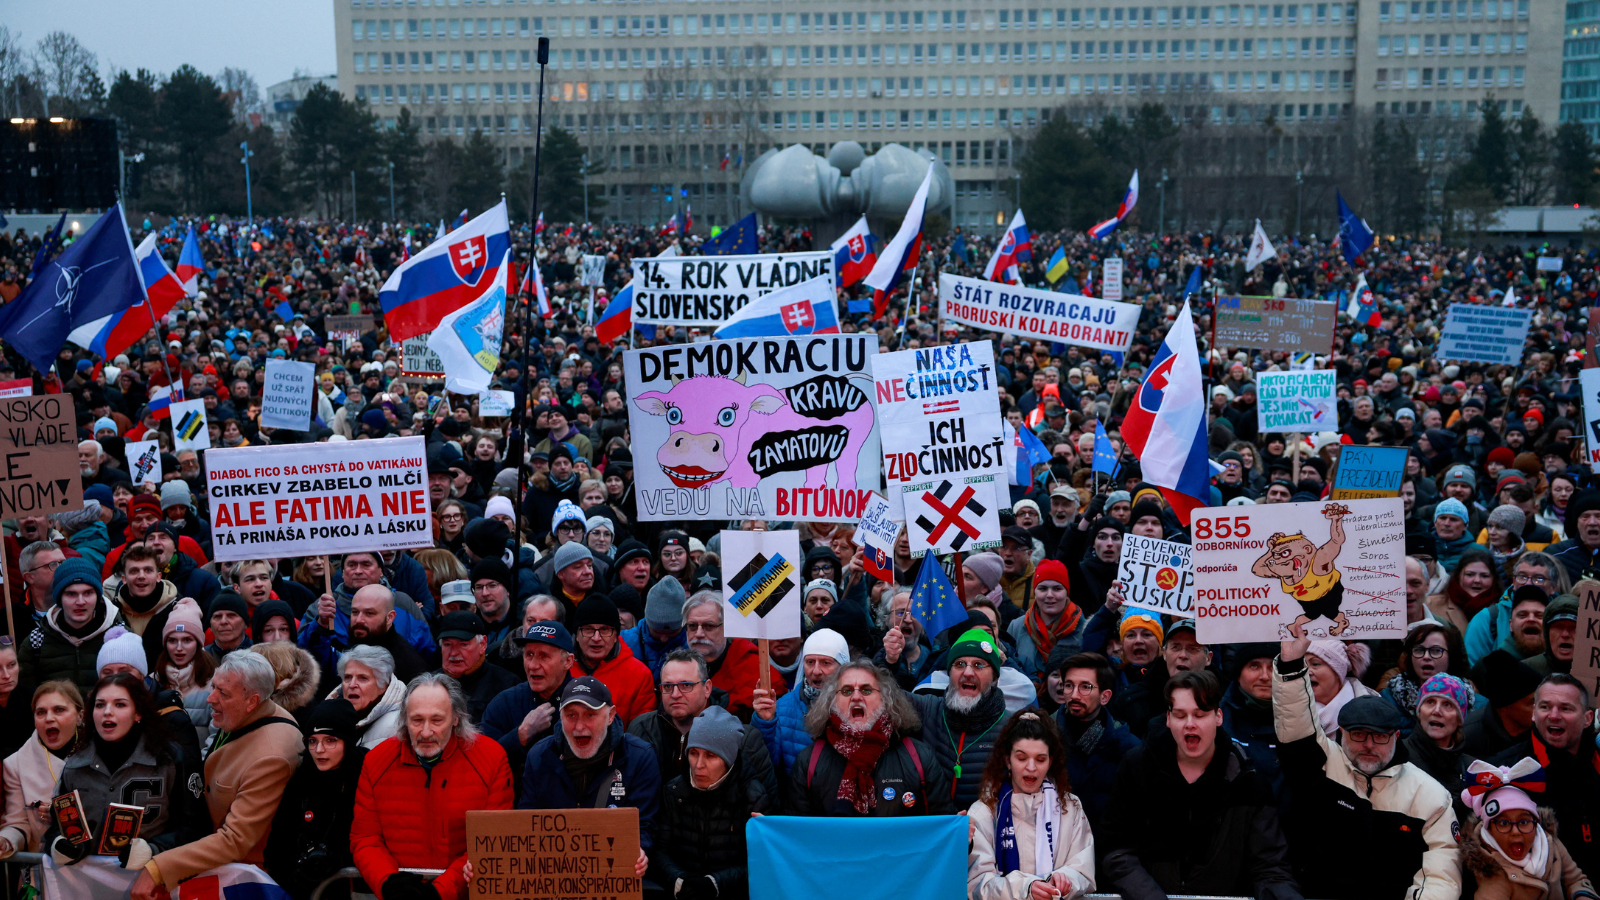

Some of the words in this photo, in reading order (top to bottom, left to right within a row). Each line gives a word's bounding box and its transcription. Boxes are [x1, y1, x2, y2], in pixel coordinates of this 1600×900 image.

[639, 261, 670, 289] 14.
[681, 262, 728, 289] ROK
[635, 292, 750, 320] SLOVENSKO
[954, 281, 993, 305] ŠTÁT
[999, 292, 1116, 325] ROZVRACAJÚ
[946, 300, 1016, 329] PRORUSKÍ
[1018, 315, 1129, 346] KOLABORANTI
[407, 358, 420, 370] TU
[639, 337, 866, 383] DEMOKRACIU
[916, 344, 974, 374] NAŠA
[271, 383, 284, 392] UŽ
[274, 372, 303, 382] CHCEM
[876, 364, 990, 404] NEČINNOSŤ
[264, 394, 308, 406] NUDNÝCH
[790, 381, 862, 412] KRAVU
[262, 406, 310, 418] POLITIKOV!
[9, 422, 74, 448] VLÁDE,
[929, 417, 966, 446] ICH
[750, 429, 848, 473] ZAMATOVÚ
[885, 436, 1004, 482] ZLOČINNOSŤ
[1344, 450, 1374, 464] PÁN
[0, 452, 32, 482] E
[210, 468, 252, 480] DIABOL
[254, 467, 280, 478] FICO
[284, 466, 298, 476] SA
[301, 461, 346, 474] CHYSTÁ
[348, 462, 364, 472] DO
[367, 457, 422, 470] VATIKÁNU
[1340, 468, 1402, 488] PREZIDENT
[211, 482, 281, 498] CIRKEV
[287, 476, 372, 494] ZBABELO
[378, 470, 422, 487] MLČÍ
[214, 501, 267, 528] ALE
[275, 494, 374, 524] FATIMA
[381, 490, 426, 516] NIE
[726, 487, 766, 516] NA
[776, 484, 873, 518] BITÚNOK
[216, 530, 236, 546] TÁ
[240, 526, 306, 544] PRINÁŠA
[310, 524, 359, 540] POKOJ
[364, 523, 374, 536] A
[378, 519, 427, 534] LÁSKU
[1195, 516, 1252, 540] 855
[1375, 510, 1394, 522] proti
[1354, 520, 1404, 532] liberalizmu
[970, 540, 1004, 551] DEPPERT!
[1196, 538, 1264, 552] ODBORNÍKOV
[1358, 532, 1404, 549] Šimečka
[1124, 548, 1140, 560] JE
[1144, 551, 1194, 570] EUROP
[1196, 563, 1238, 574] odporúča
[1359, 552, 1390, 560] Soros
[1378, 562, 1396, 571] proti
[735, 590, 757, 611] MIER
[752, 558, 788, 595] UKRAJINE
[1120, 560, 1194, 594] STOP
[1118, 582, 1192, 612] RUSKU
[1197, 584, 1270, 600] POLITICKÝ
[1198, 603, 1280, 618] DÔCHODOK
[1345, 608, 1396, 618] Rómovia
[476, 836, 497, 852] MY
[499, 836, 536, 852] VIEME
[539, 835, 566, 852] KTO
[570, 834, 601, 852] STE
[478, 858, 504, 875] STE
[510, 853, 536, 875] PLNÍ
[538, 852, 600, 875] NENÁVISTI
[476, 878, 504, 894] STE
